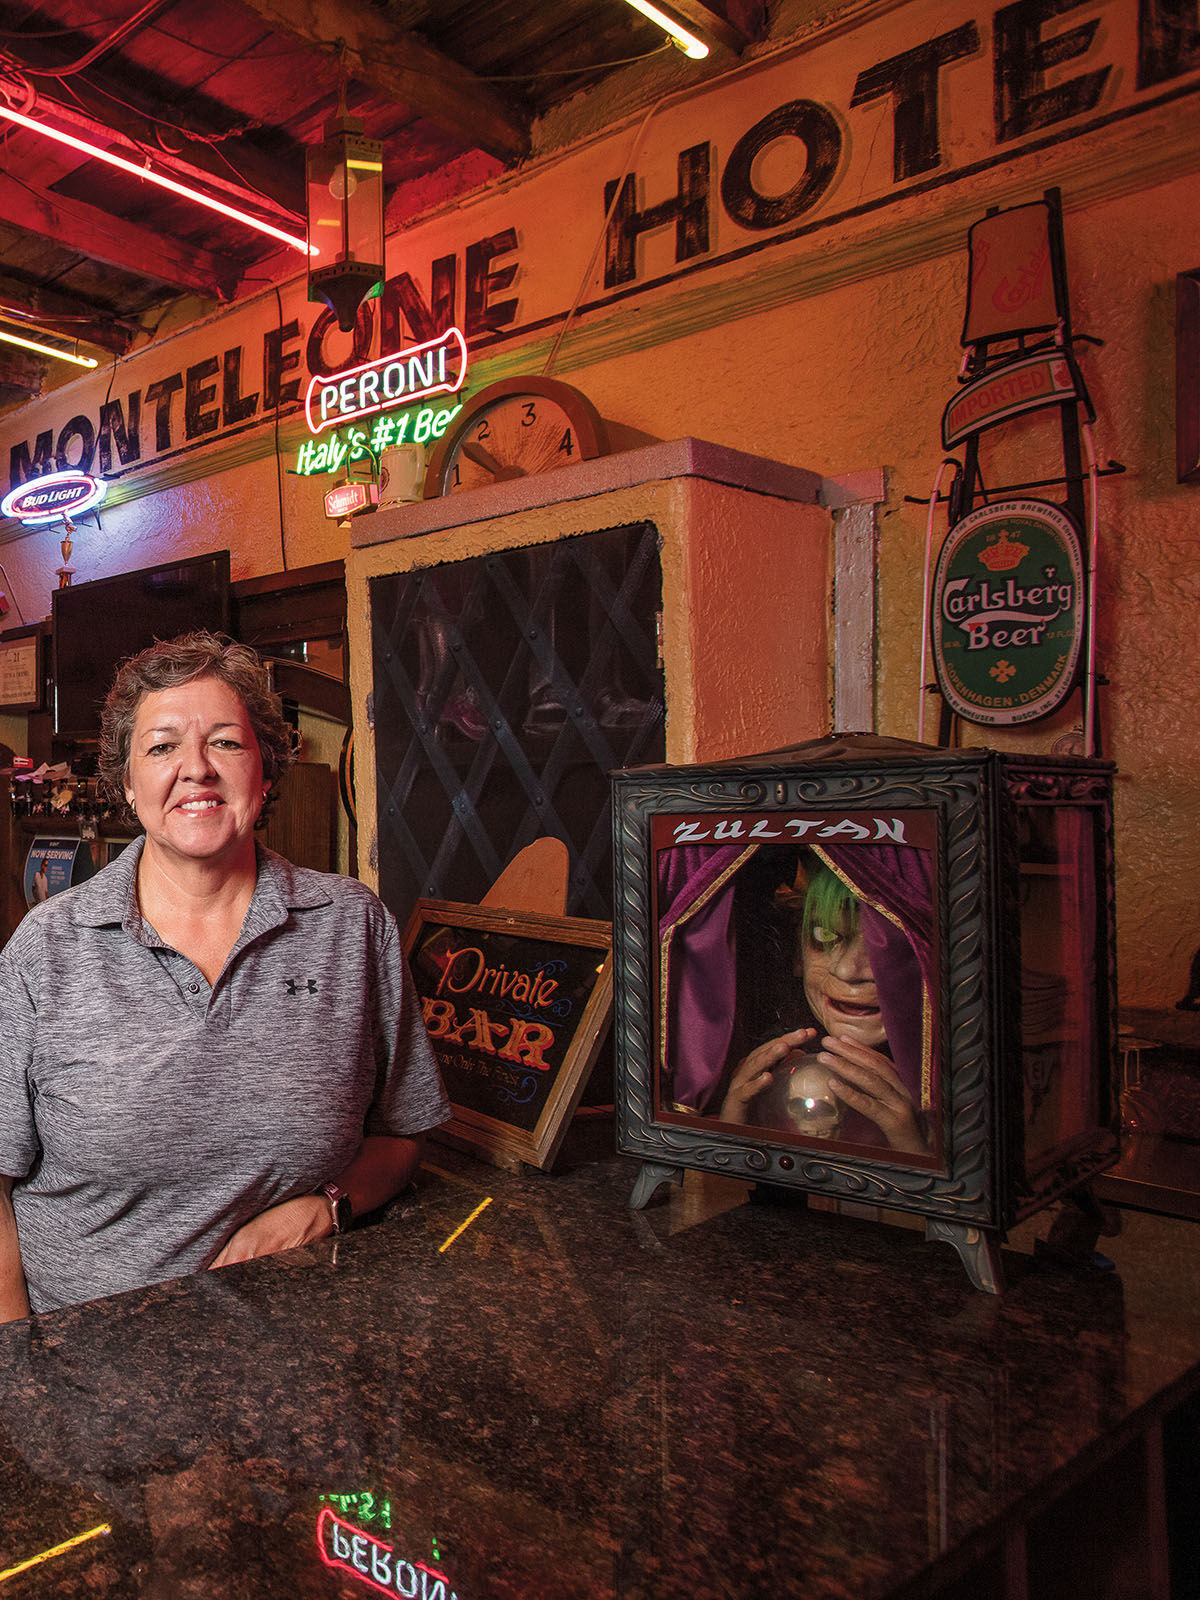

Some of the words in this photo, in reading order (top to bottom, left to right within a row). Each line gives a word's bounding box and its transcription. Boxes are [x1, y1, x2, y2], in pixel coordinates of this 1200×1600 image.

[8, 227, 520, 487] MONTELEONE
[321, 347, 447, 420] PERONI
[950, 369, 1047, 428] IMPORTED
[296, 428, 367, 475] Italy's
[371, 413, 410, 453] #1
[453, 463, 463, 488] 1
[476, 420, 491, 441] 2
[521, 402, 537, 427] 3
[558, 427, 574, 457] 4
[328, 490, 359, 513] Schmidt
[967, 501, 1016, 525] CARLSBERG
[943, 578, 1073, 622] Carlsberg
[967, 621, 1047, 650] Beer
[946, 662, 1013, 707] COPENHAGEN
[1019, 654, 1067, 701] DENMARK
[30, 850, 48, 859] NOW
[46, 850, 74, 860] SERVING
[673, 818, 908, 844] ZULTAN
[436, 947, 560, 1009] Private
[421, 996, 556, 1071] BAR
